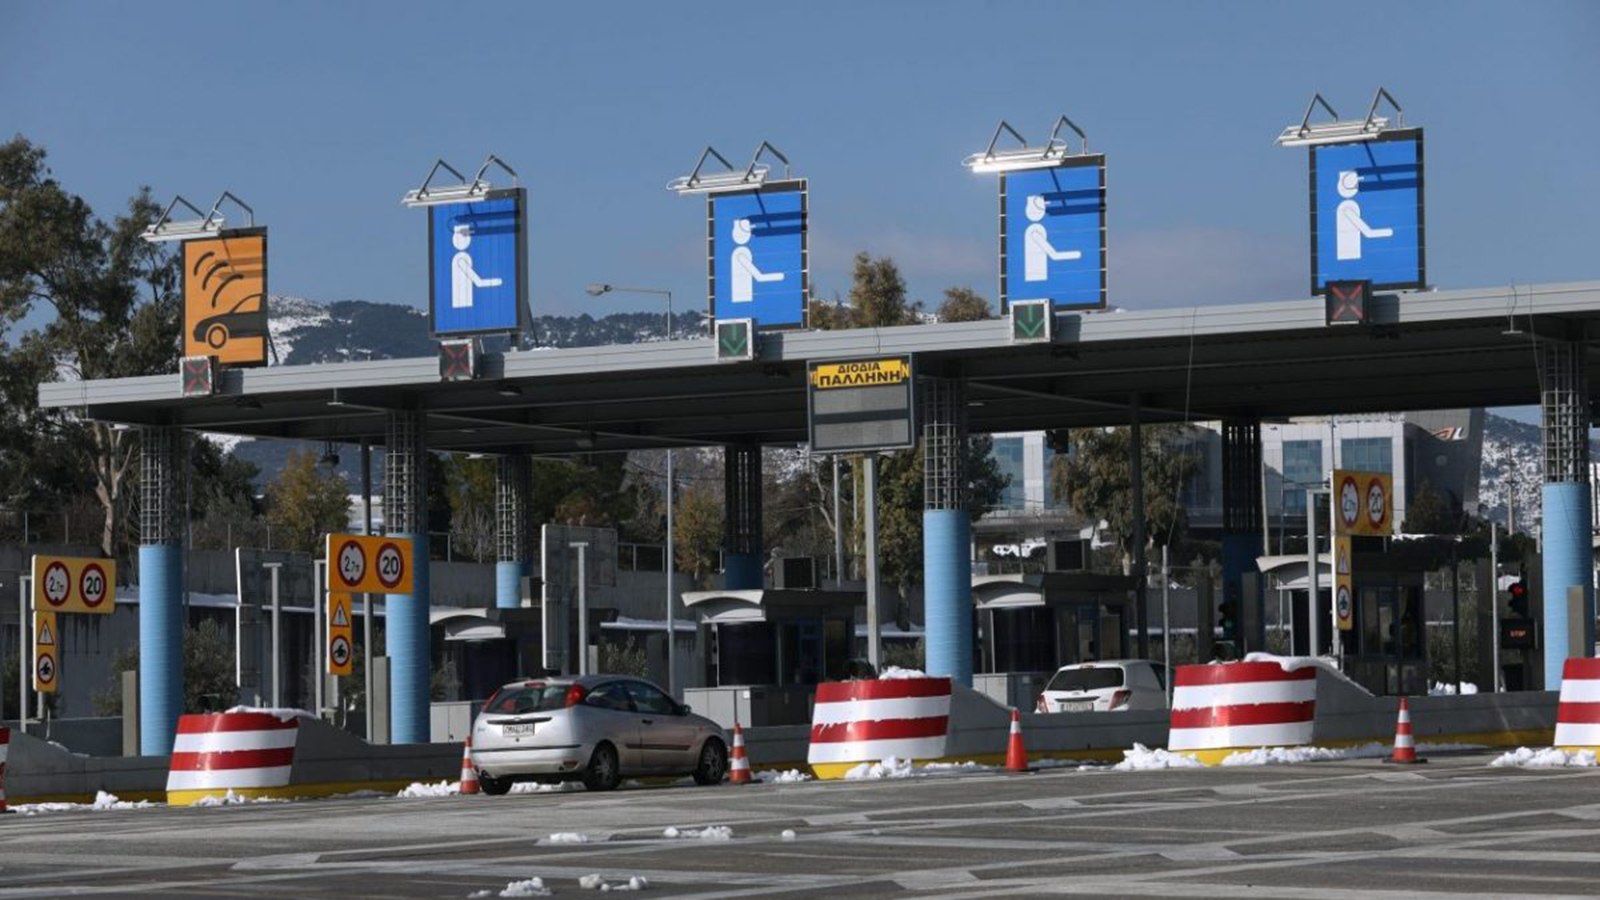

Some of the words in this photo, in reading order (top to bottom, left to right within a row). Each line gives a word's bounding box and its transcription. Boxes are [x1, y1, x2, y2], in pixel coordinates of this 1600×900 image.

[838, 362, 880, 373] ΔΙΟΔΙΑ
[820, 370, 900, 385] ΠΑΛΛΗΝΗ
[382, 555, 398, 575] 20
[86, 576, 101, 594] 20
